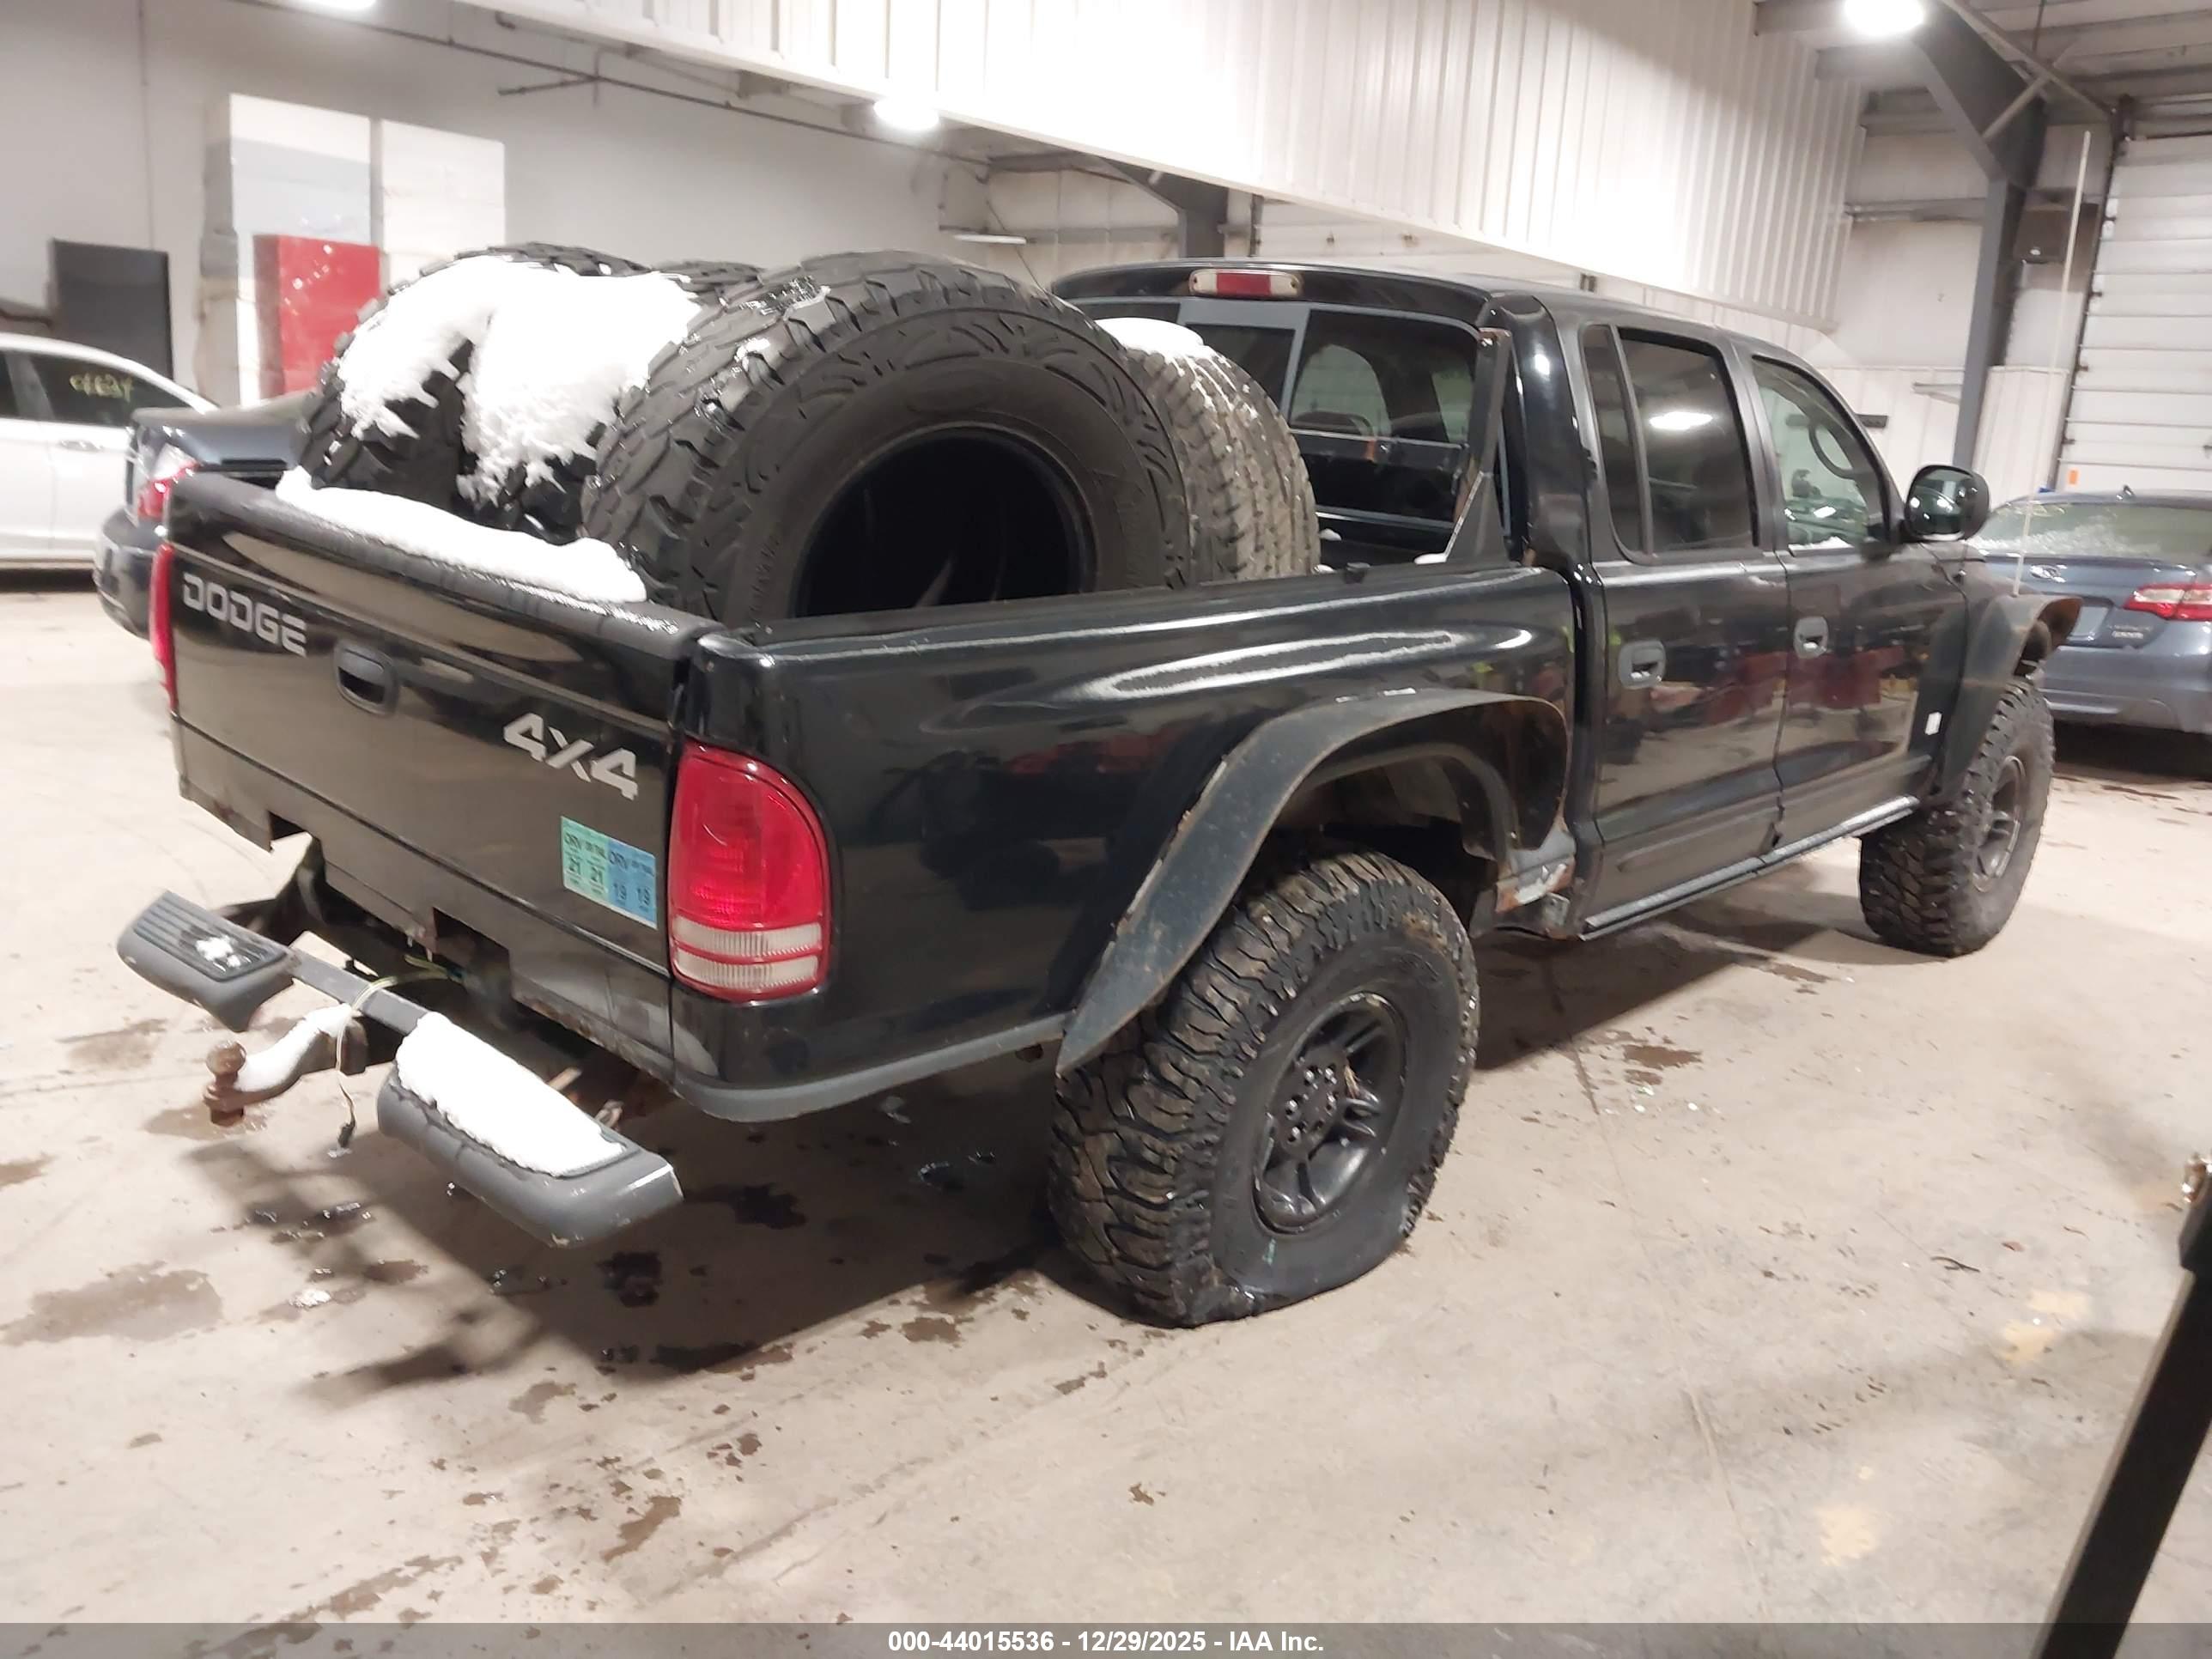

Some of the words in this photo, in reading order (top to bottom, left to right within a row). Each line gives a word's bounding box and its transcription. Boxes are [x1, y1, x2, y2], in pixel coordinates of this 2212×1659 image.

[182, 571, 307, 659] DODGE
[503, 712, 639, 801] 4X4
[568, 857, 581, 875] 21
[590, 866, 604, 885] 21
